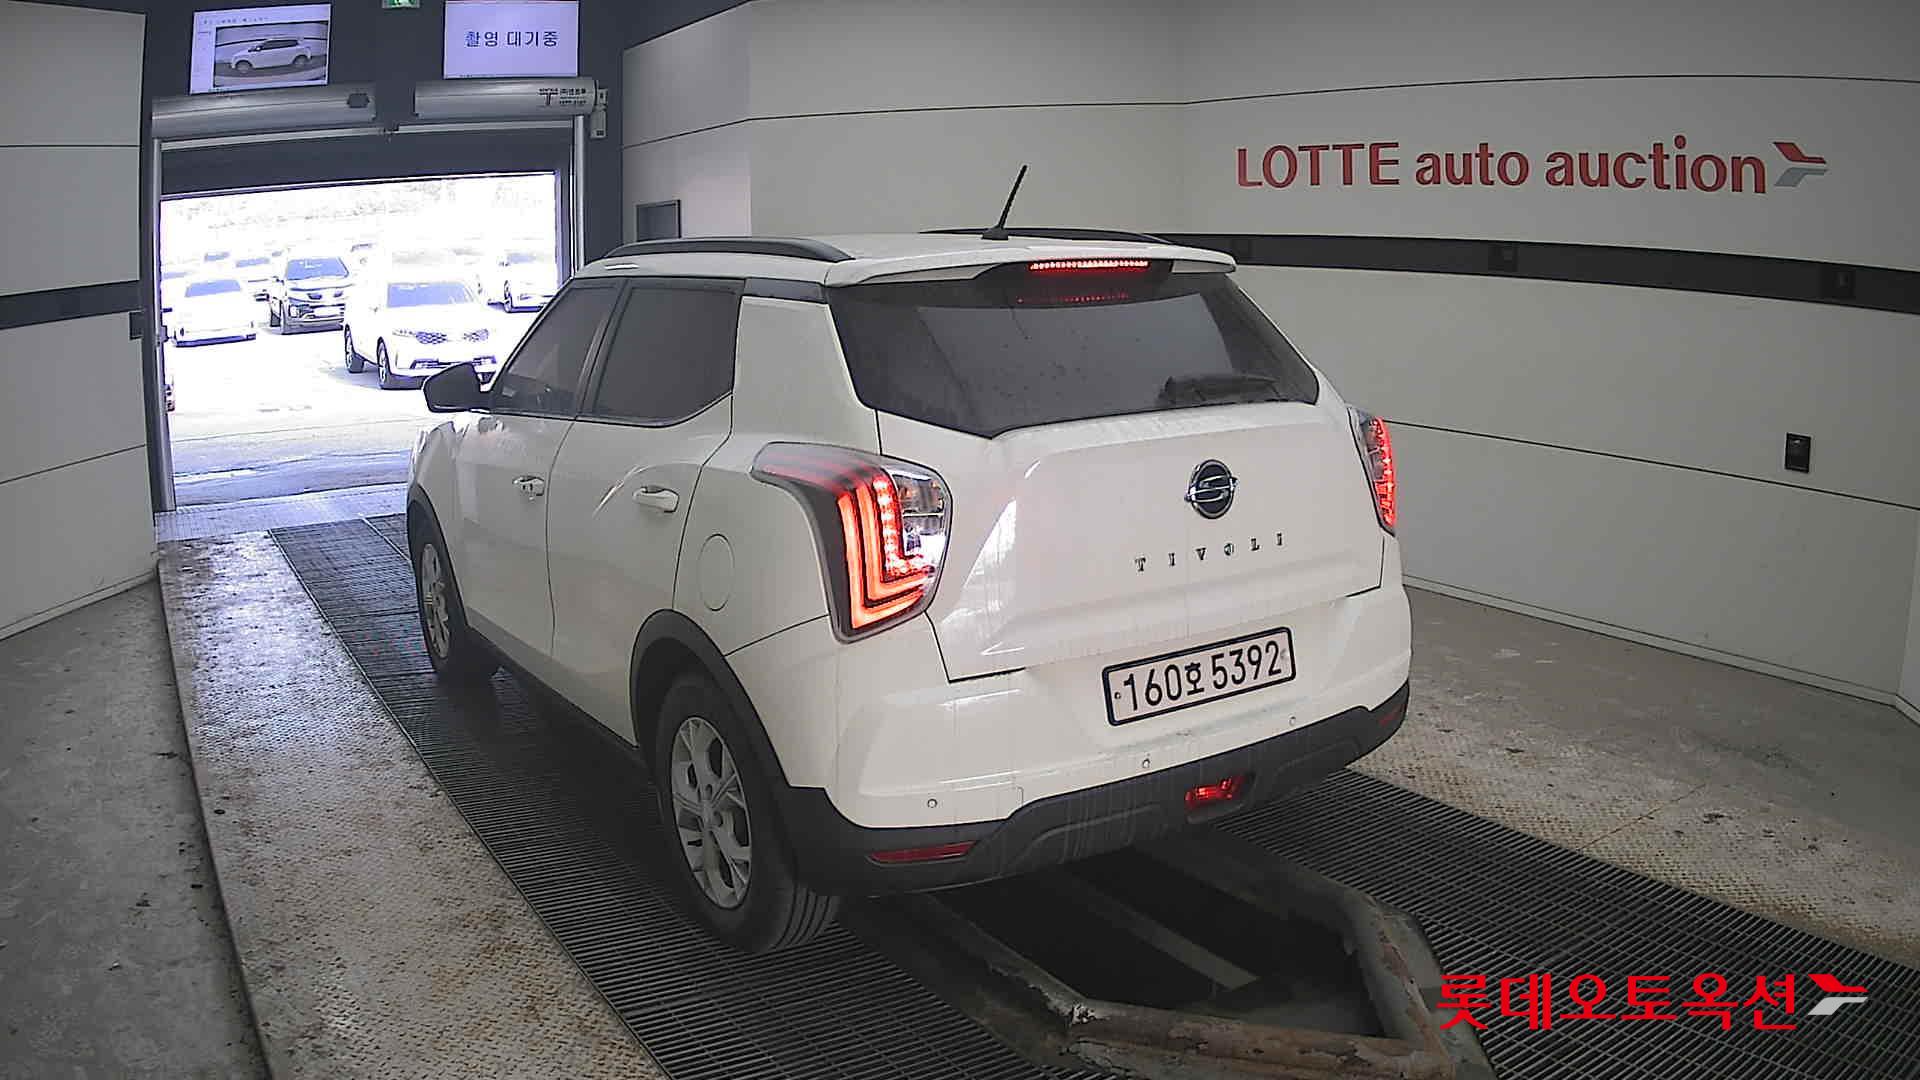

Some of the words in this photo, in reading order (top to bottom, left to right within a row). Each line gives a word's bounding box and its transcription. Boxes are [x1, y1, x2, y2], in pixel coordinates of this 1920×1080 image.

[507, 31, 559, 48] 대기중
[1236, 142, 1400, 188] LOTTE
[1414, 143, 1530, 186] auto
[1546, 135, 1767, 194] auction
[1135, 532, 1284, 572] TIVOLI
